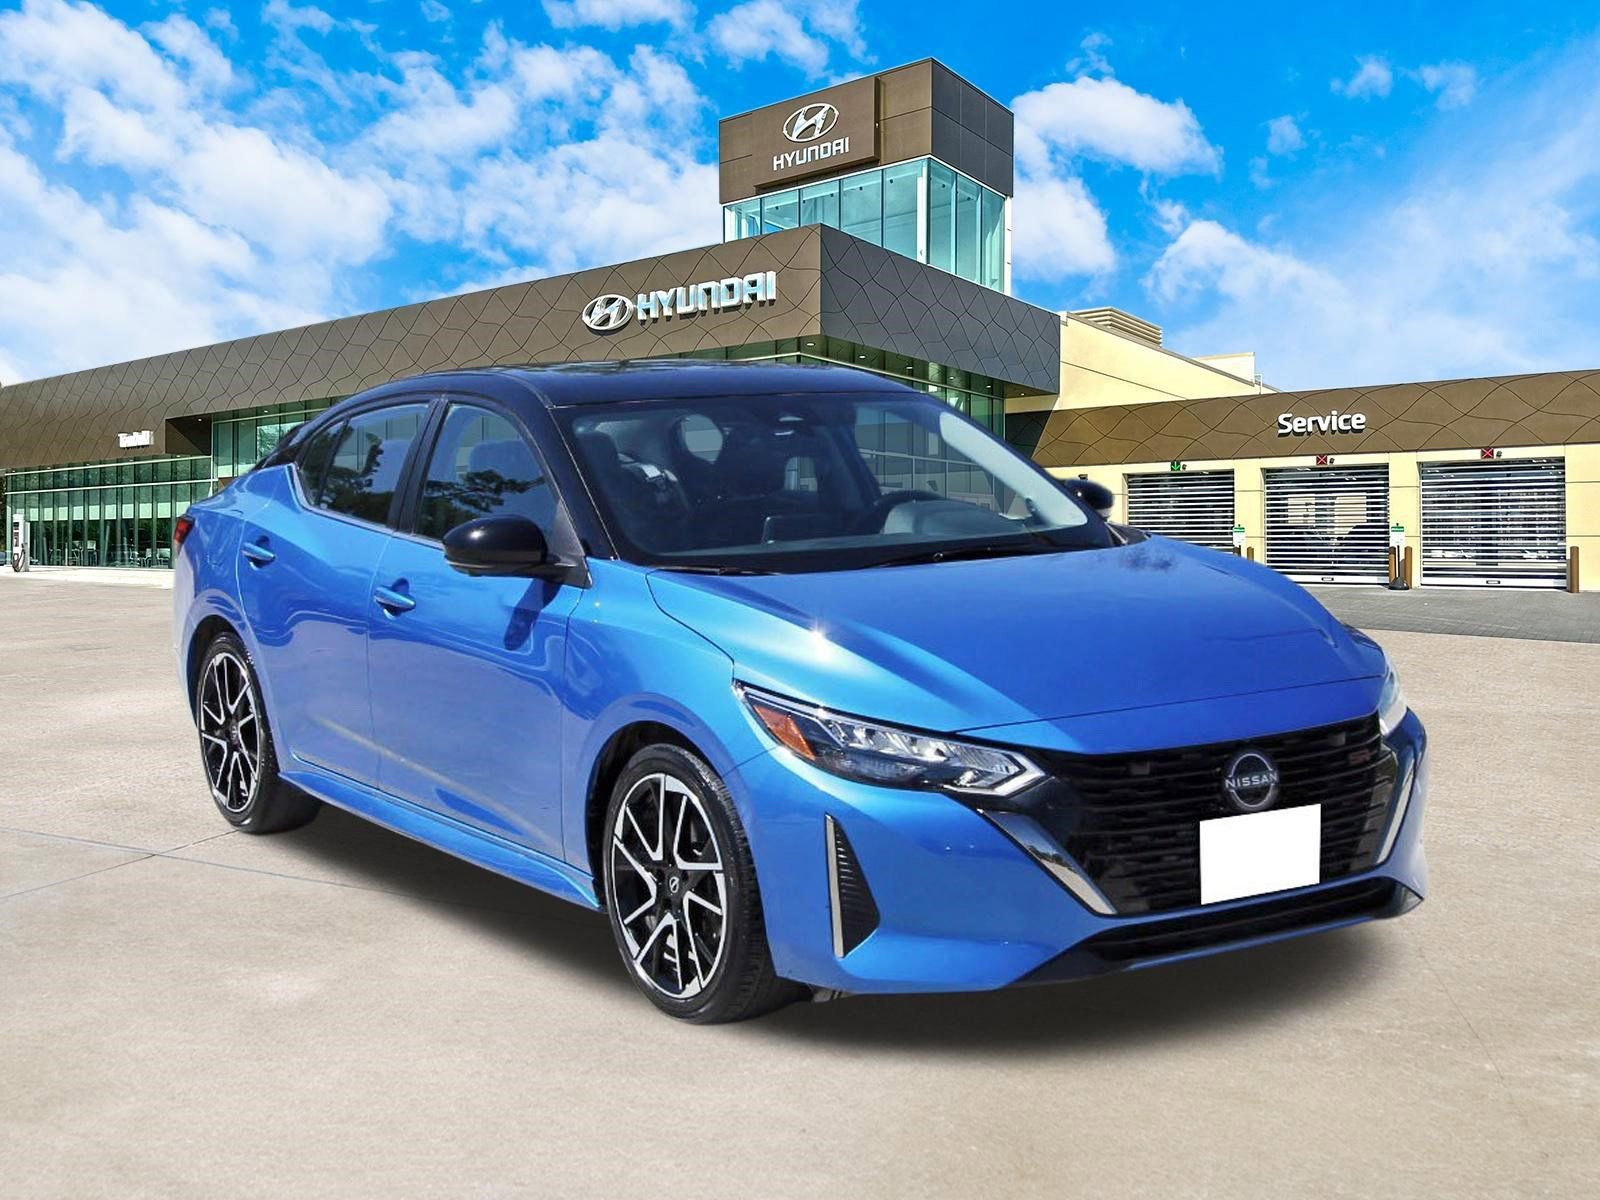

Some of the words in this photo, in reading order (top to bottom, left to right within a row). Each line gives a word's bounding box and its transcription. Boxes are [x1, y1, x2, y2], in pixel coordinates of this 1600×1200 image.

[773, 137, 849, 171] HYUNDAI
[637, 271, 776, 320] HYUNDAI
[1278, 410, 1366, 434] Service
[1225, 771, 1277, 788] NISSAN
